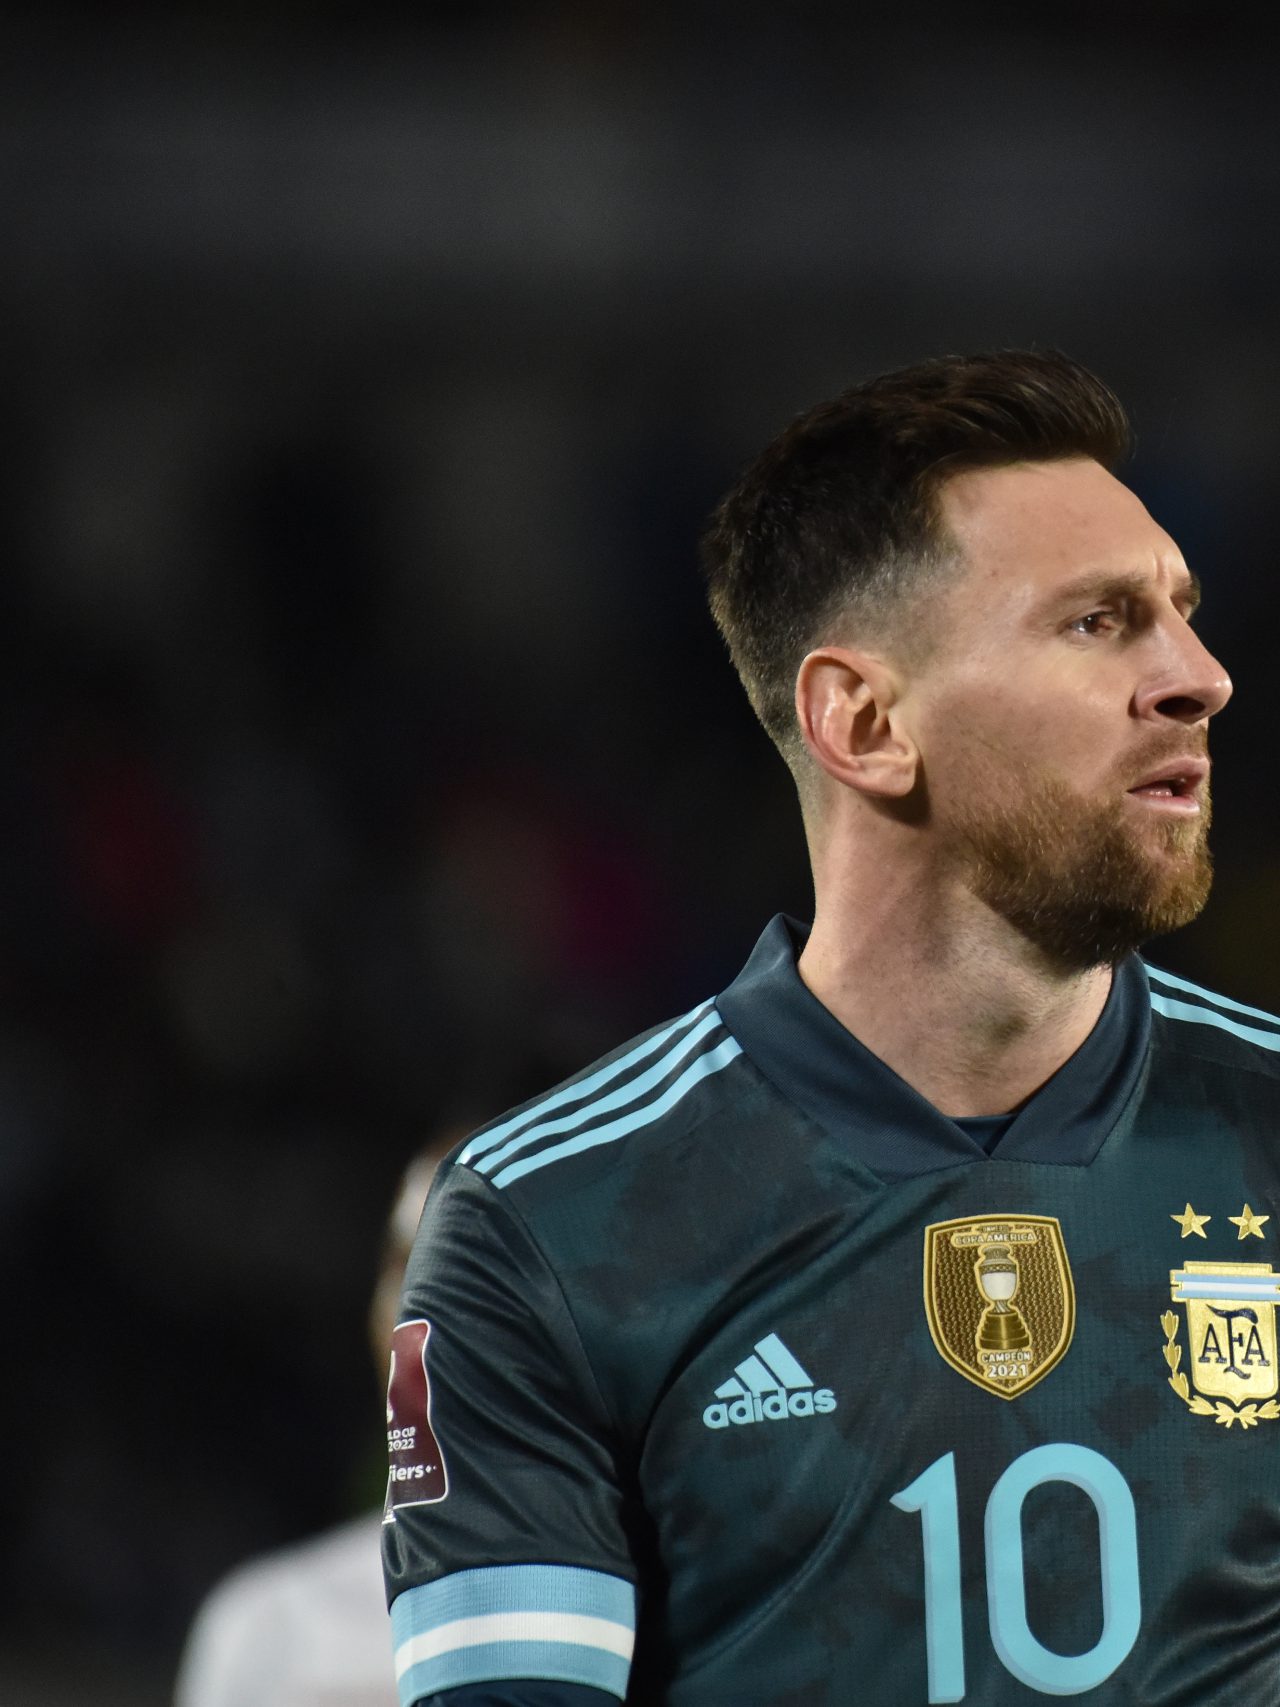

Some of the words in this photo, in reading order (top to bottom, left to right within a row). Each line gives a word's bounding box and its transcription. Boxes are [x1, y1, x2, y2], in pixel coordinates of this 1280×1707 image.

[955, 1235, 984, 1245] COPA
[1198, 1304, 1270, 1380] AFA
[988, 1364, 1027, 1378] 2021
[703, 1387, 837, 1429] adidas
[402, 1426, 416, 1438] CUP
[388, 1438, 415, 1452] 2022
[889, 1442, 1141, 1705] 10
